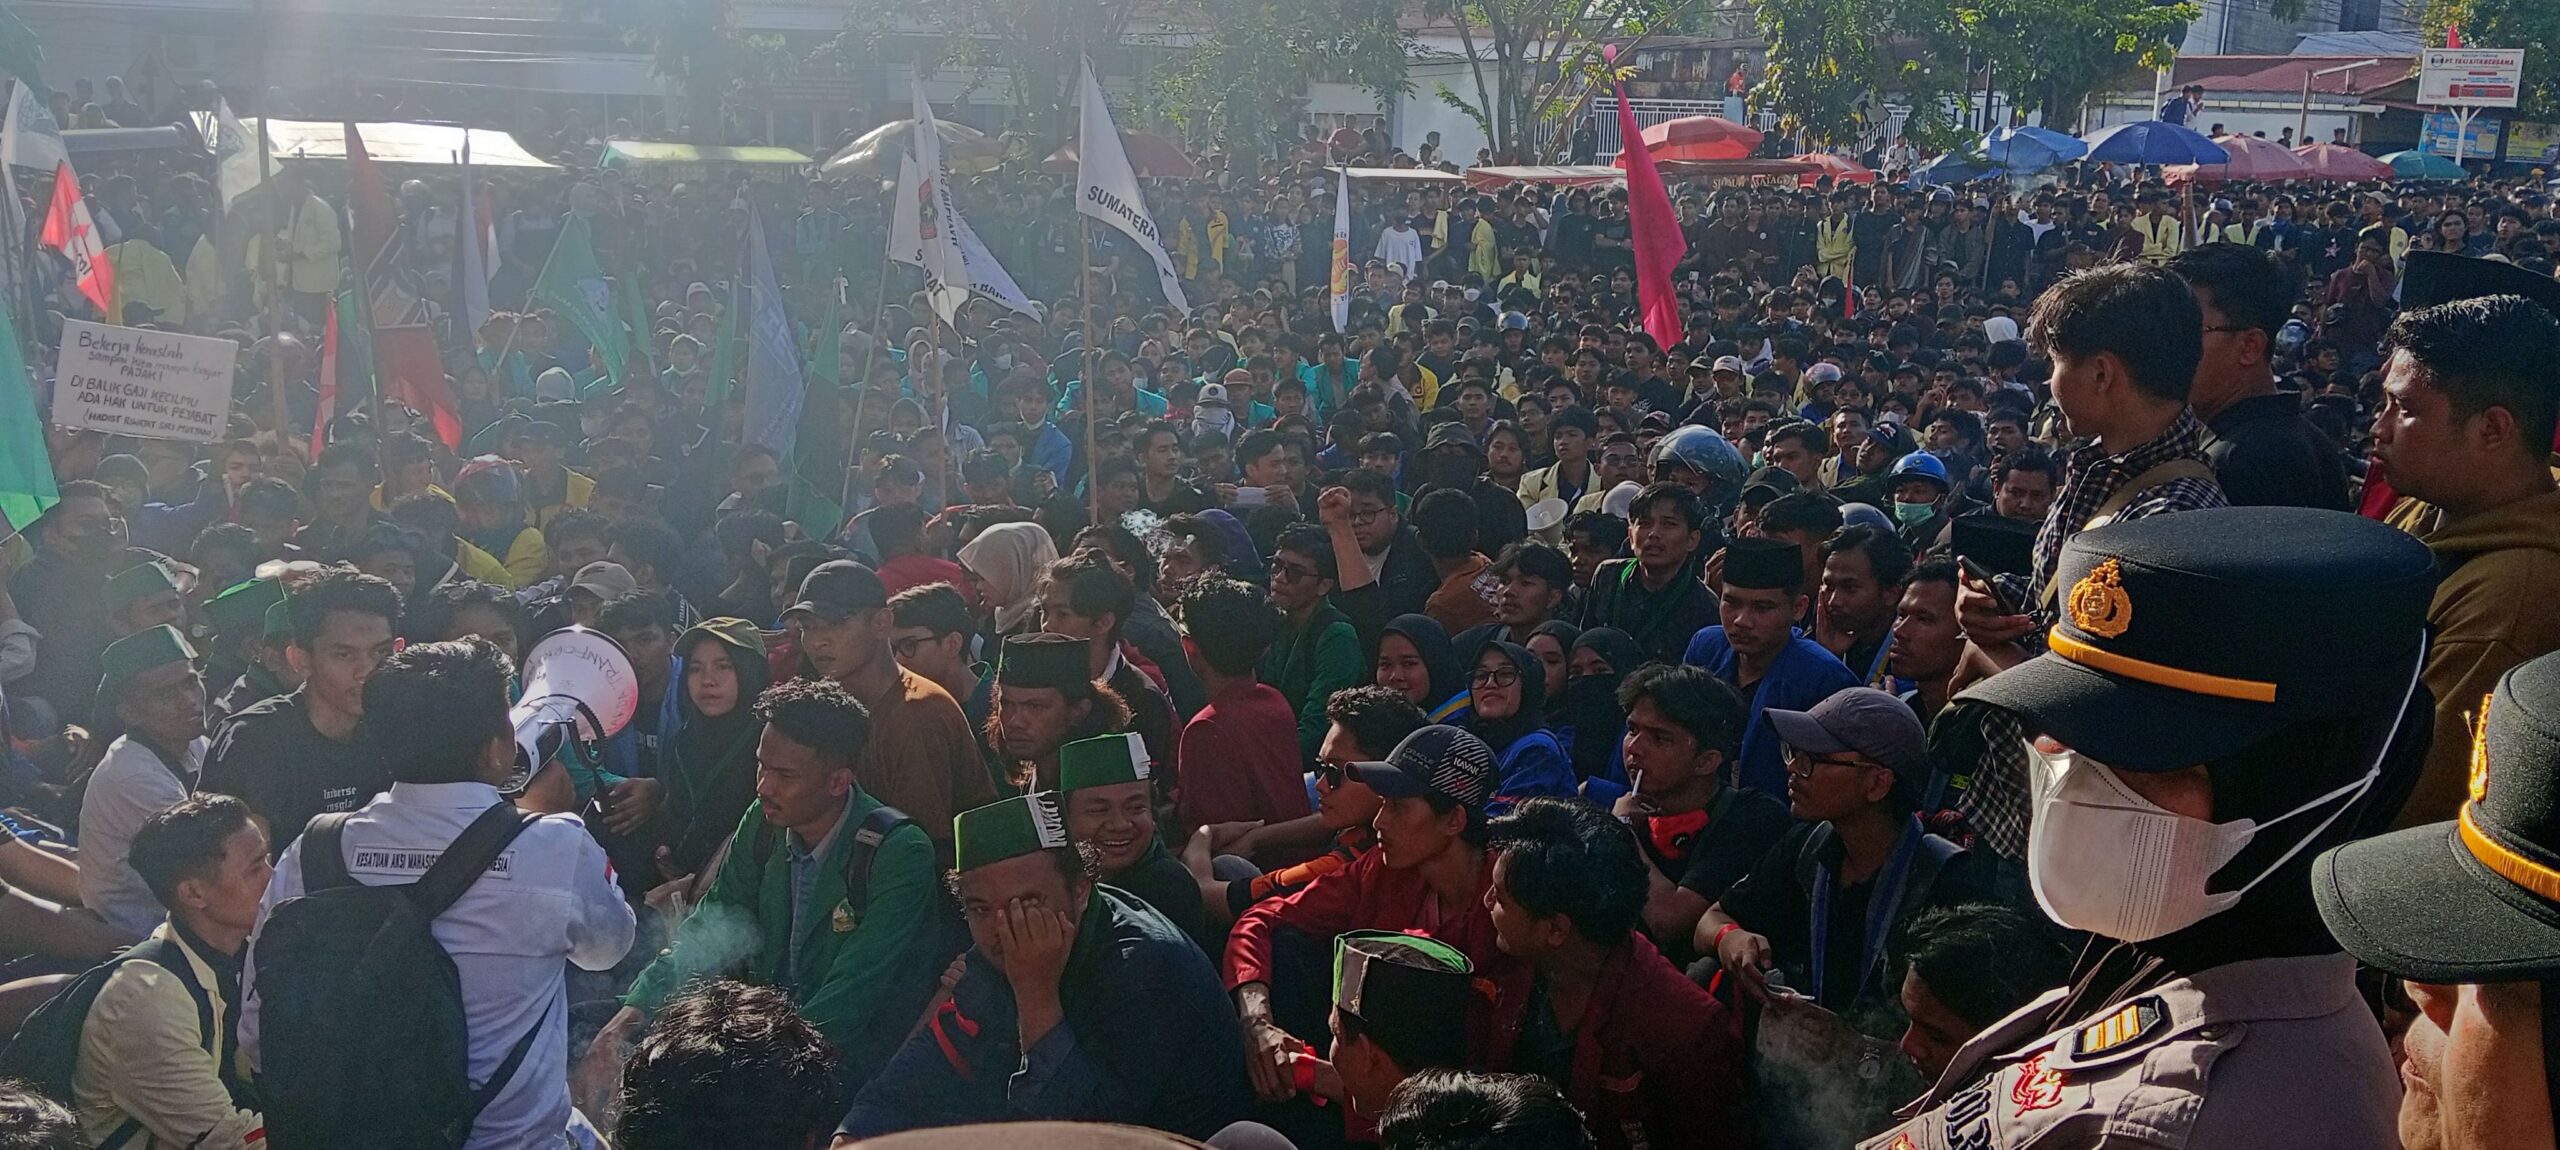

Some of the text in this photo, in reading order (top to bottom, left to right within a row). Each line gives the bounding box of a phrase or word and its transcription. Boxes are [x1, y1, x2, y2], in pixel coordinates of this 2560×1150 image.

[1087, 185, 1156, 242] SUMATERA
[79, 330, 131, 356] Bekerja
[70, 374, 200, 407] DI BALIK GAJI KECILMU
[76, 391, 100, 406] ADA
[103, 394, 127, 409] HAK
[131, 399, 169, 416] UNTUK
[355, 851, 509, 873] KESATUAN AKSI MAHASIS ESIA
